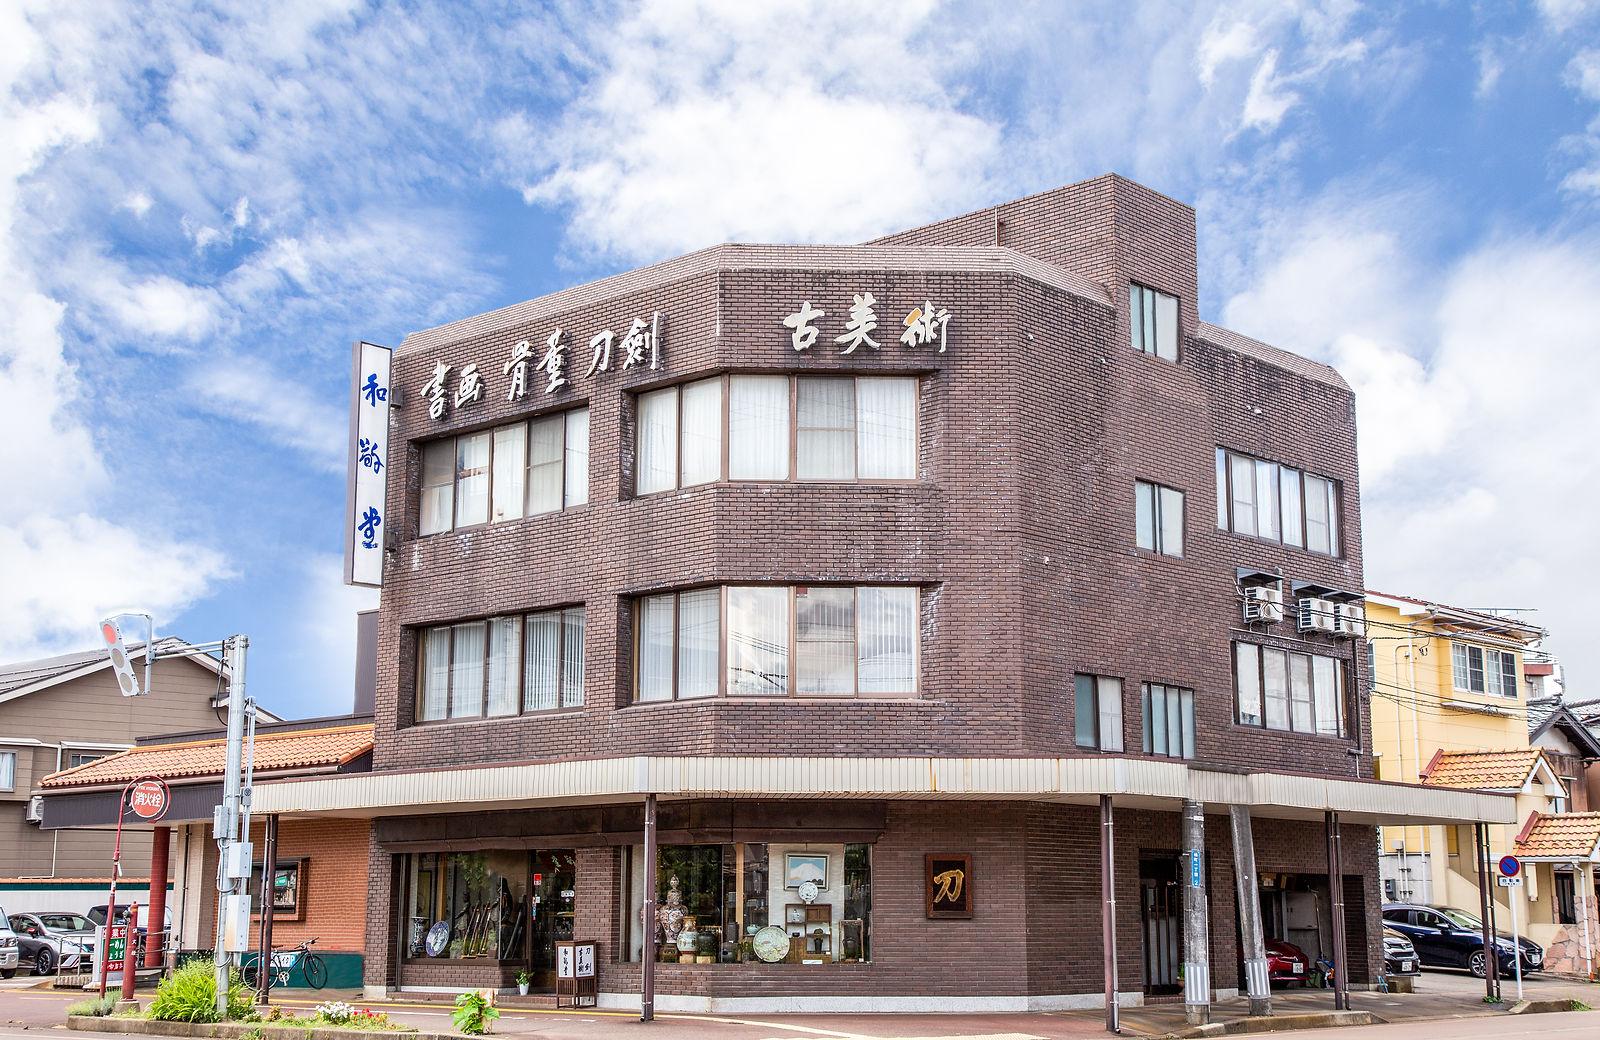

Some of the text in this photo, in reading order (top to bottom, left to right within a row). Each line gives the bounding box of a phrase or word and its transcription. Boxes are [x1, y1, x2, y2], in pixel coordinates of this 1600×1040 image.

[782, 291, 952, 356] 古美術
[420, 359, 484, 420] 書画
[357, 373, 388, 550] 和敬堂
[135, 792, 161, 806] 消火栓
[933, 869, 964, 903] 刀
